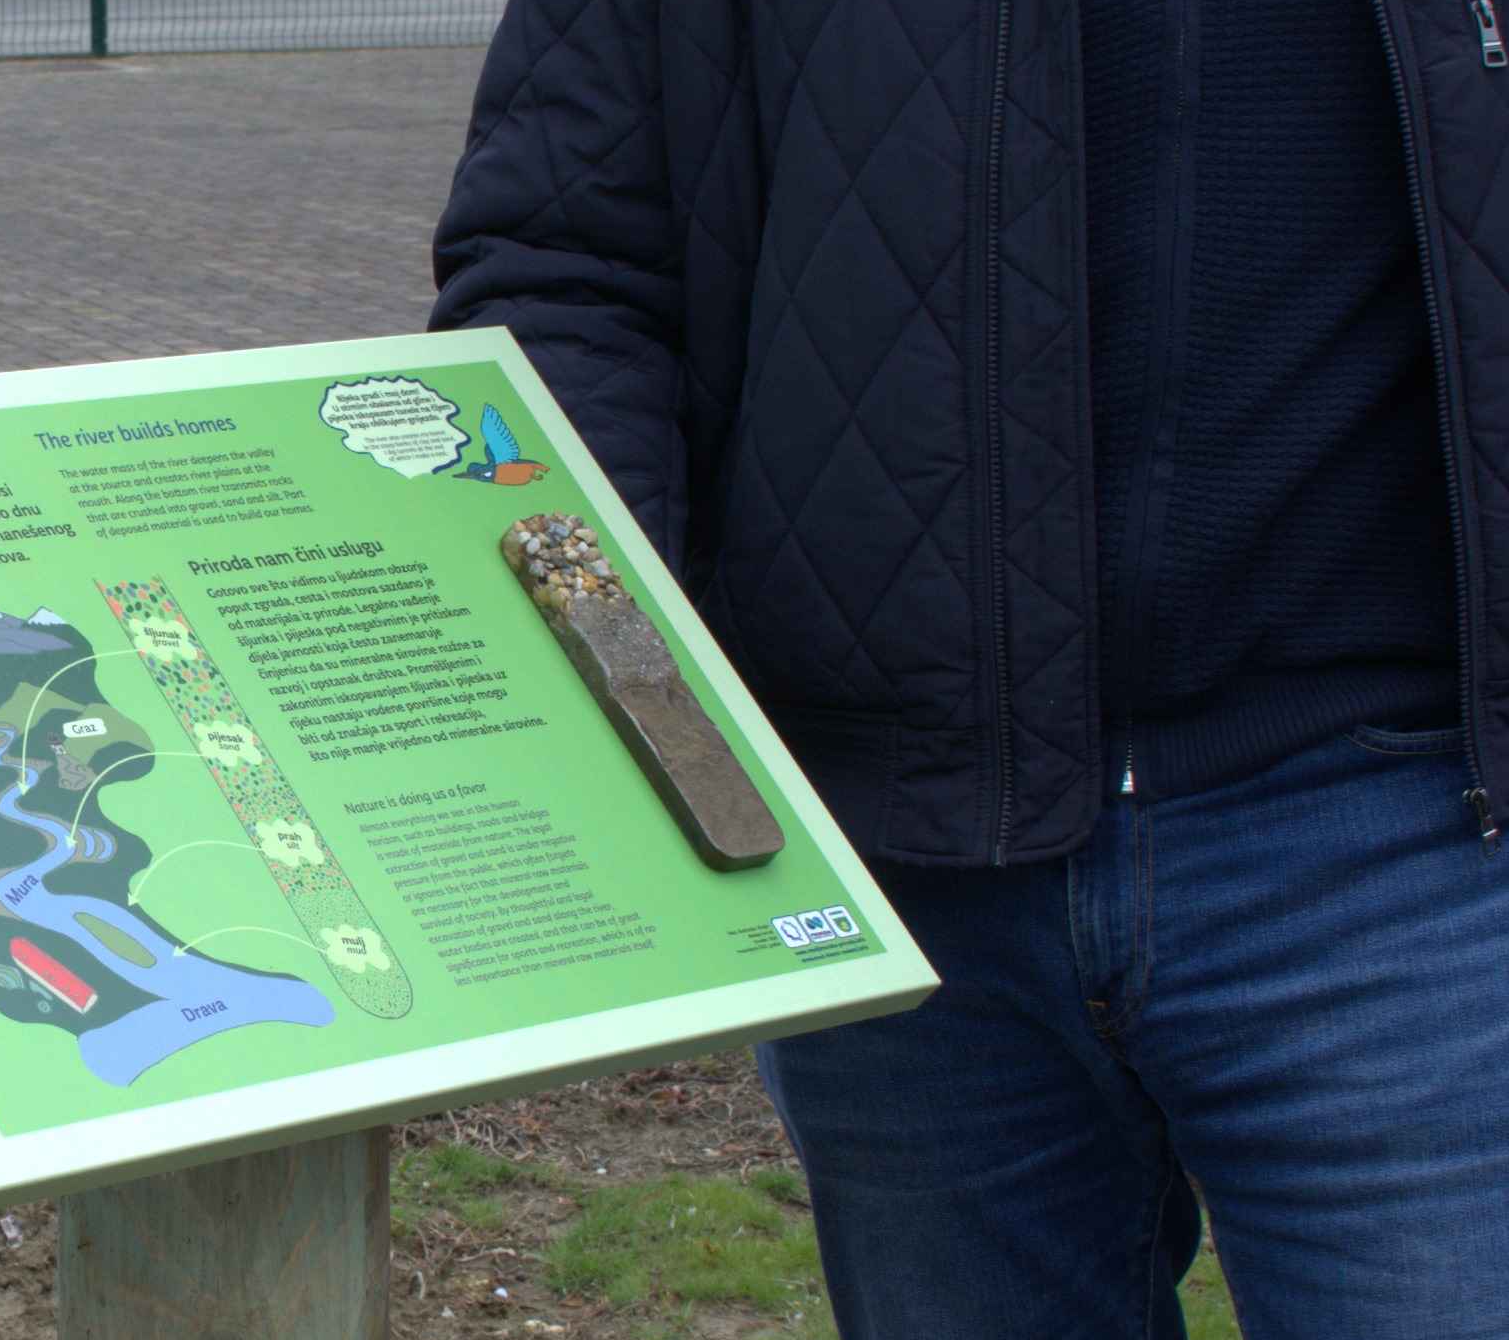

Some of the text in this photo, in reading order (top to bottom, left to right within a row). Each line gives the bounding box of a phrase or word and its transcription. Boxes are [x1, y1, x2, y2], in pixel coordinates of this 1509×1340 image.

[34, 418, 237, 450] The river builds homes
[12, 504, 42, 517] dnu
[188, 541, 384, 575] Priroda nam čini uslugu
[143, 626, 182, 640] šljunak
[71, 724, 99, 735] Graz
[208, 731, 246, 745] pijesak
[297, 730, 320, 745] biti
[336, 722, 380, 739] značaja
[393, 718, 425, 732] sport
[308, 751, 330, 762] što
[330, 746, 352, 760] nije
[352, 740, 387, 755] manje
[386, 735, 432, 750] vrijedno
[448, 724, 503, 739] mineralne
[344, 783, 486, 814] Nature is doing us a favor
[4, 873, 39, 906] Mura
[341, 936, 366, 951] mulj
[180, 1000, 228, 1022] Drava
